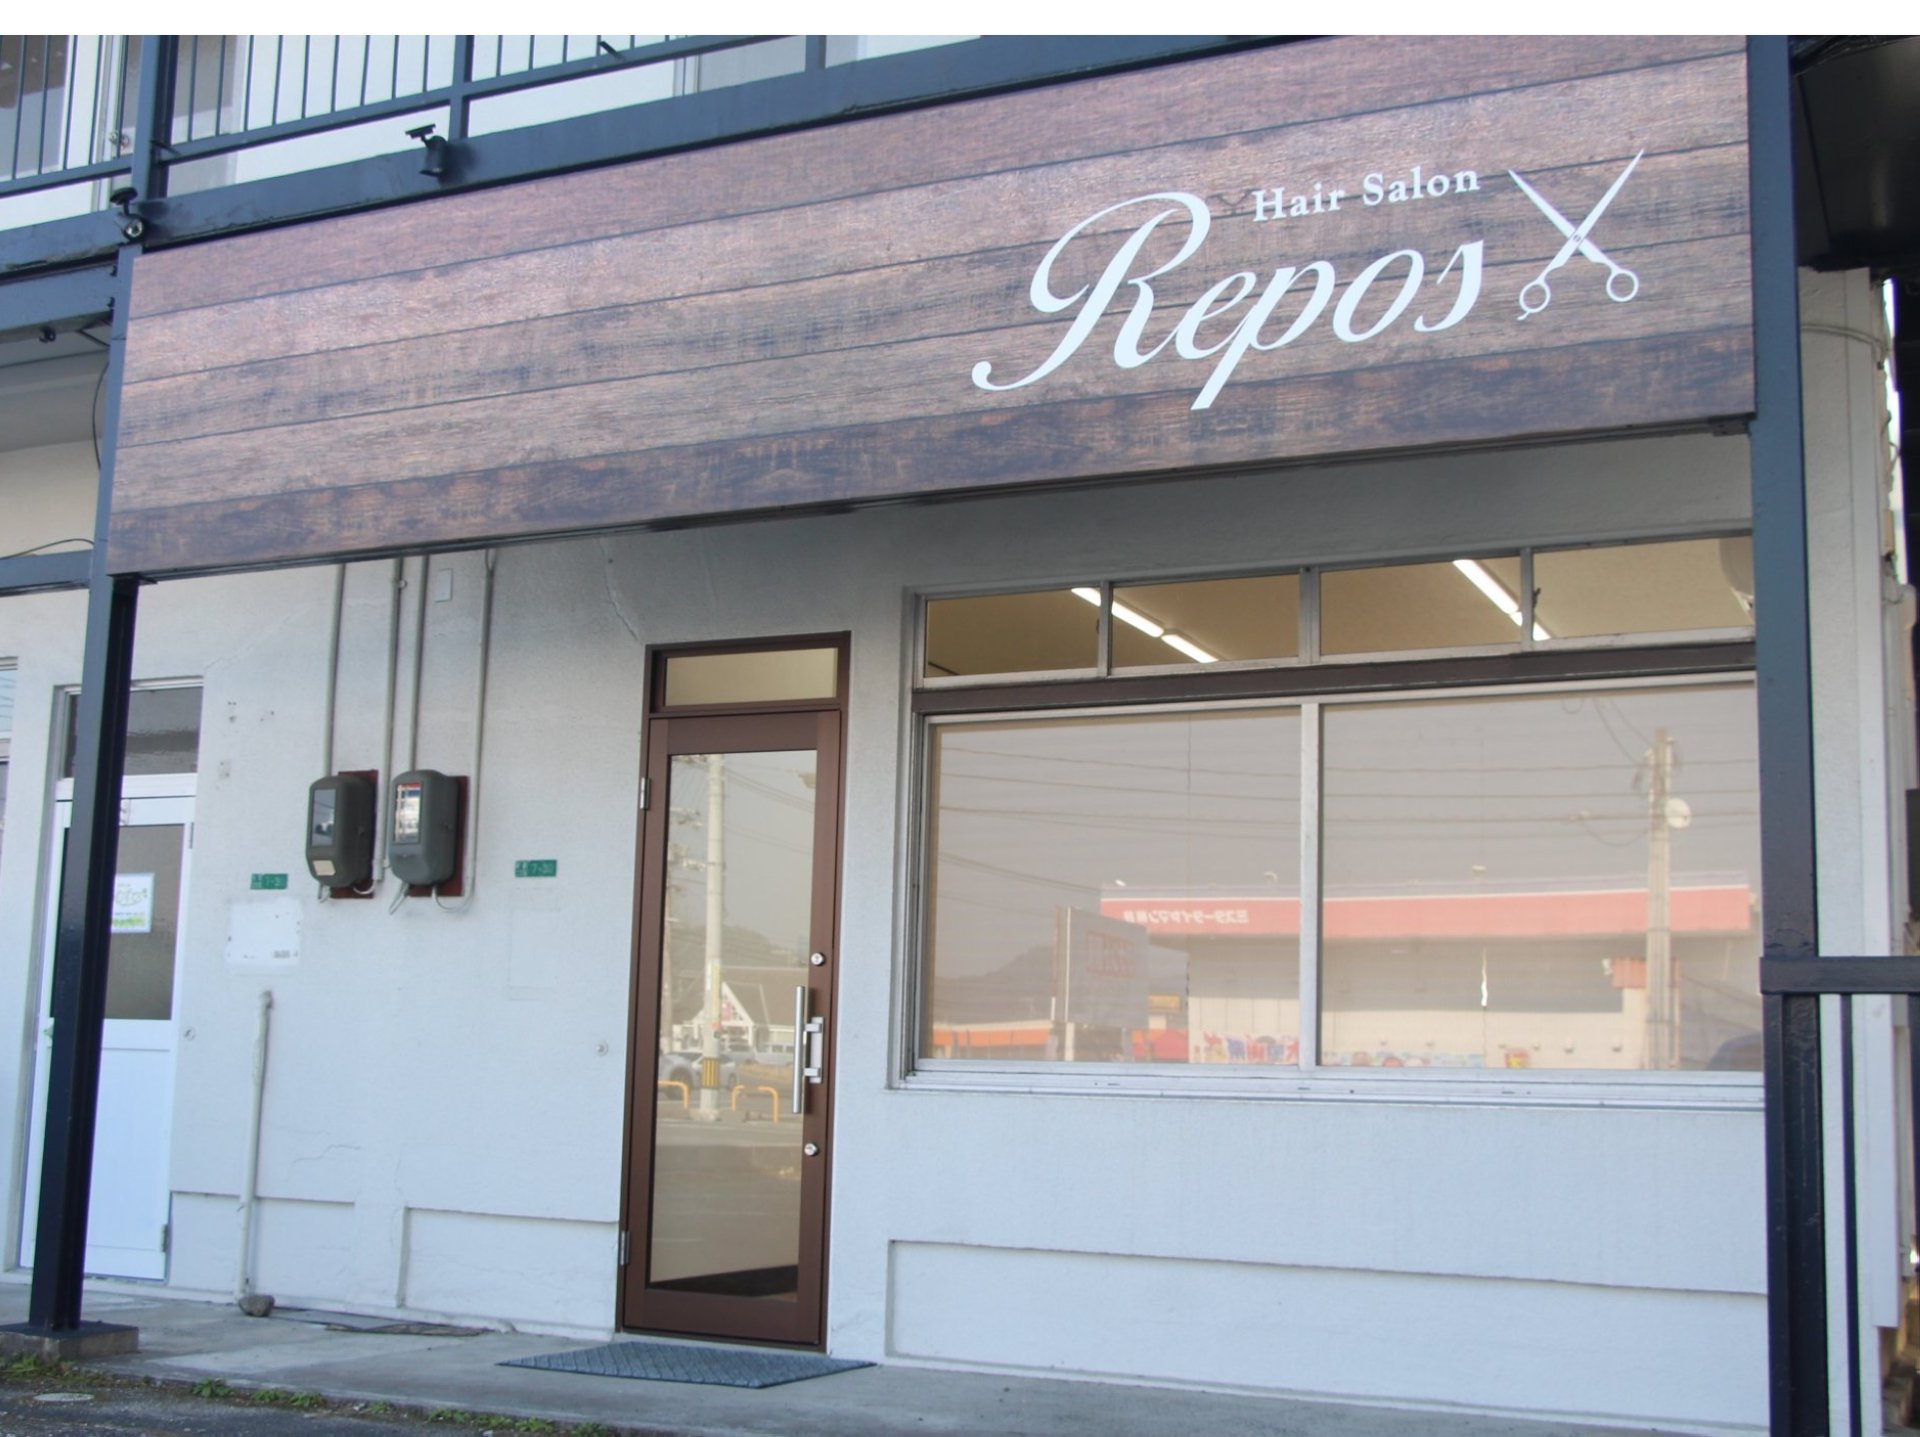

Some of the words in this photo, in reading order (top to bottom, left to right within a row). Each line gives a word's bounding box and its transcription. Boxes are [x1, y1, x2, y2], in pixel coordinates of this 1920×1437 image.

[1252, 182, 1343, 222] Hair
[1362, 166, 1481, 206] Salon
[972, 191, 1485, 411] Repos
